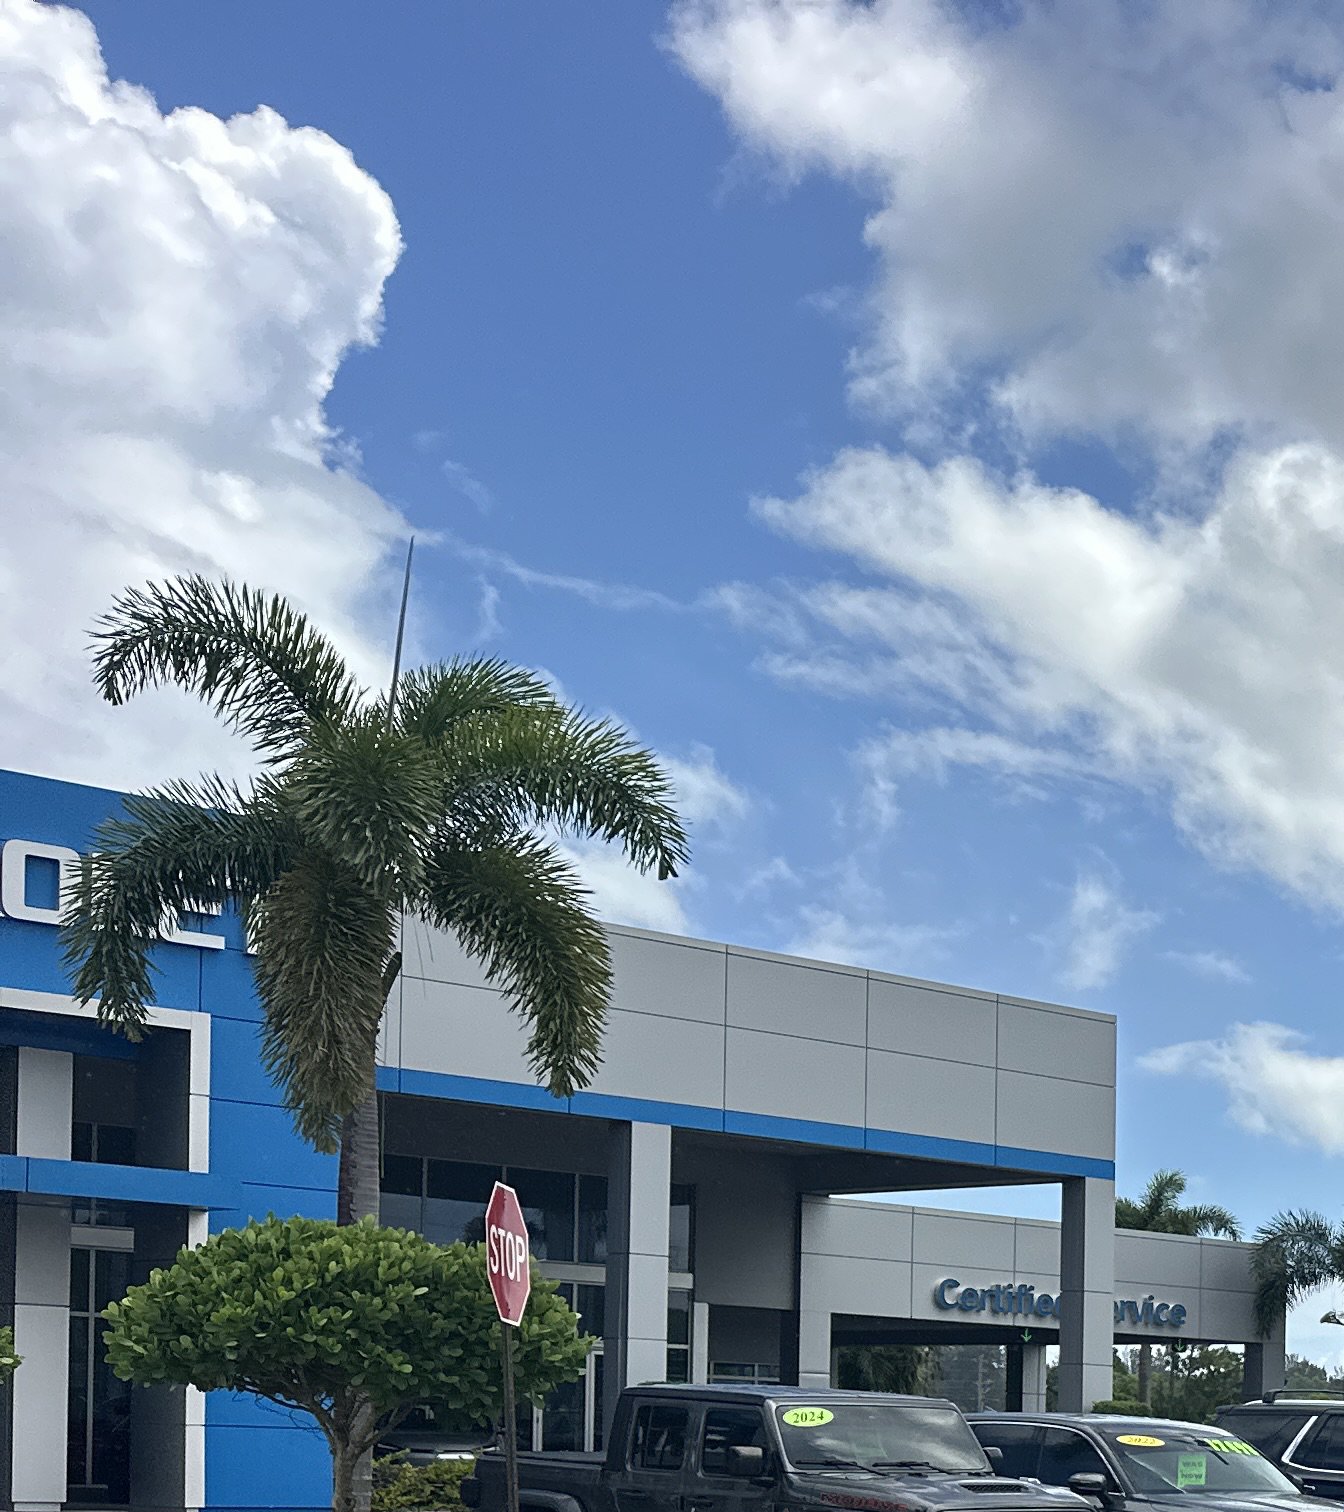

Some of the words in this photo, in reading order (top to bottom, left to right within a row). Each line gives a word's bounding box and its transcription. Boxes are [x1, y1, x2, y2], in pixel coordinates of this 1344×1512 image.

[489, 1224, 526, 1282] STOP
[1114, 1295, 1187, 1326] rvice
[792, 1410, 825, 1424] 2024
